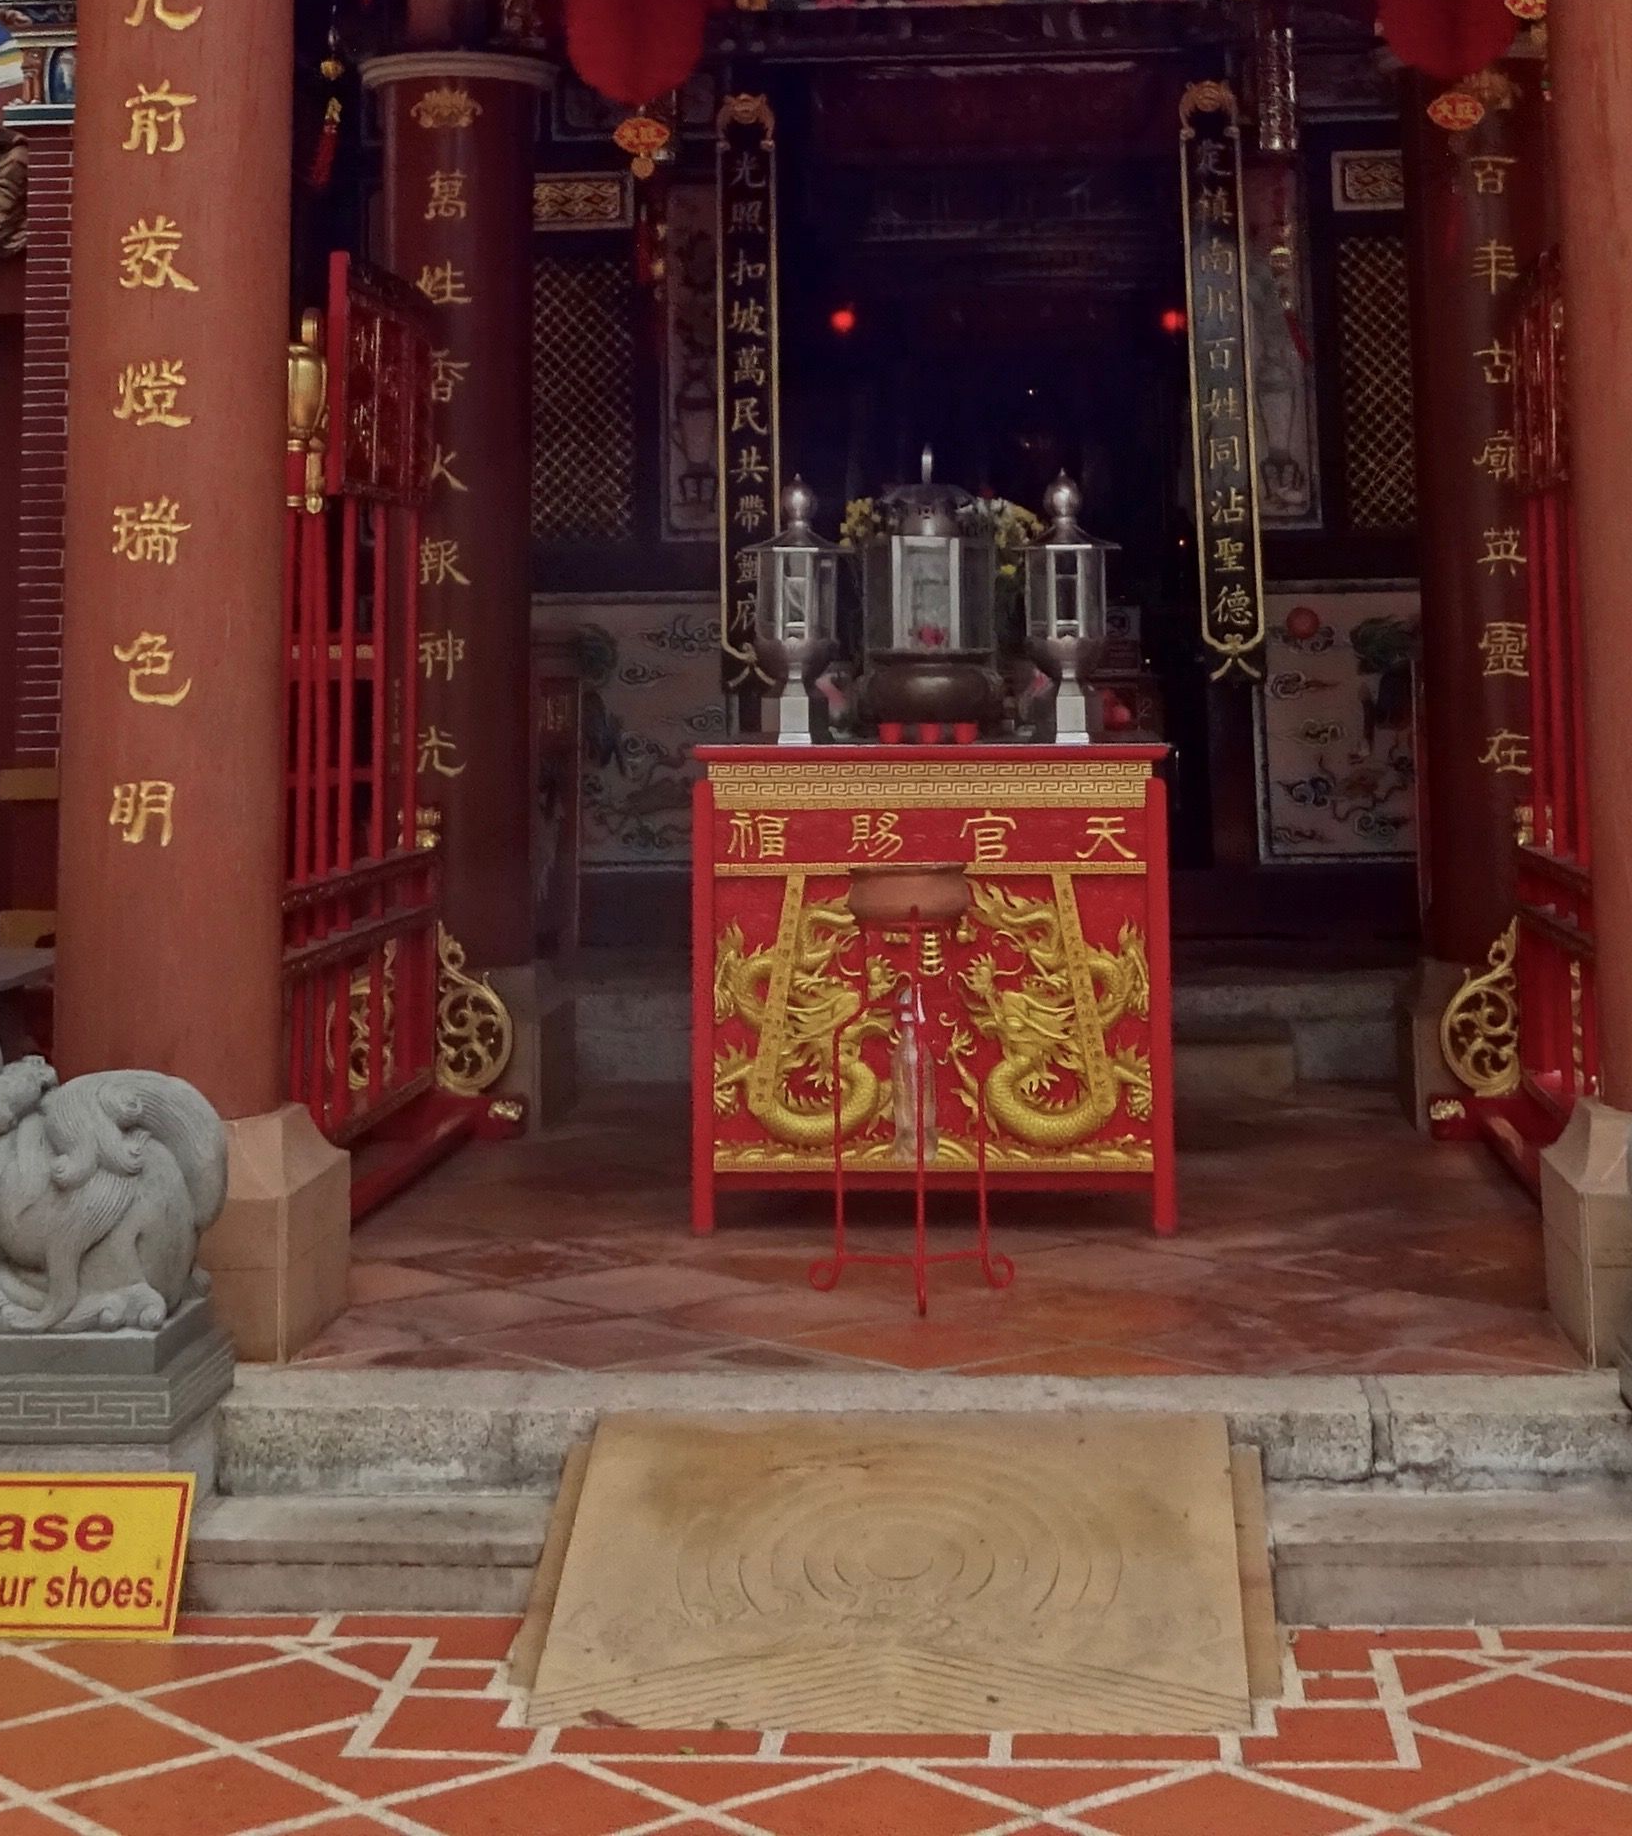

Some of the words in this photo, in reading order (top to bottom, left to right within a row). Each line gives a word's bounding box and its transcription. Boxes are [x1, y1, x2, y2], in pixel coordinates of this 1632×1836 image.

[728, 810, 1138, 863] 天官賜福
[44, 1566, 164, 1609] shoes.
